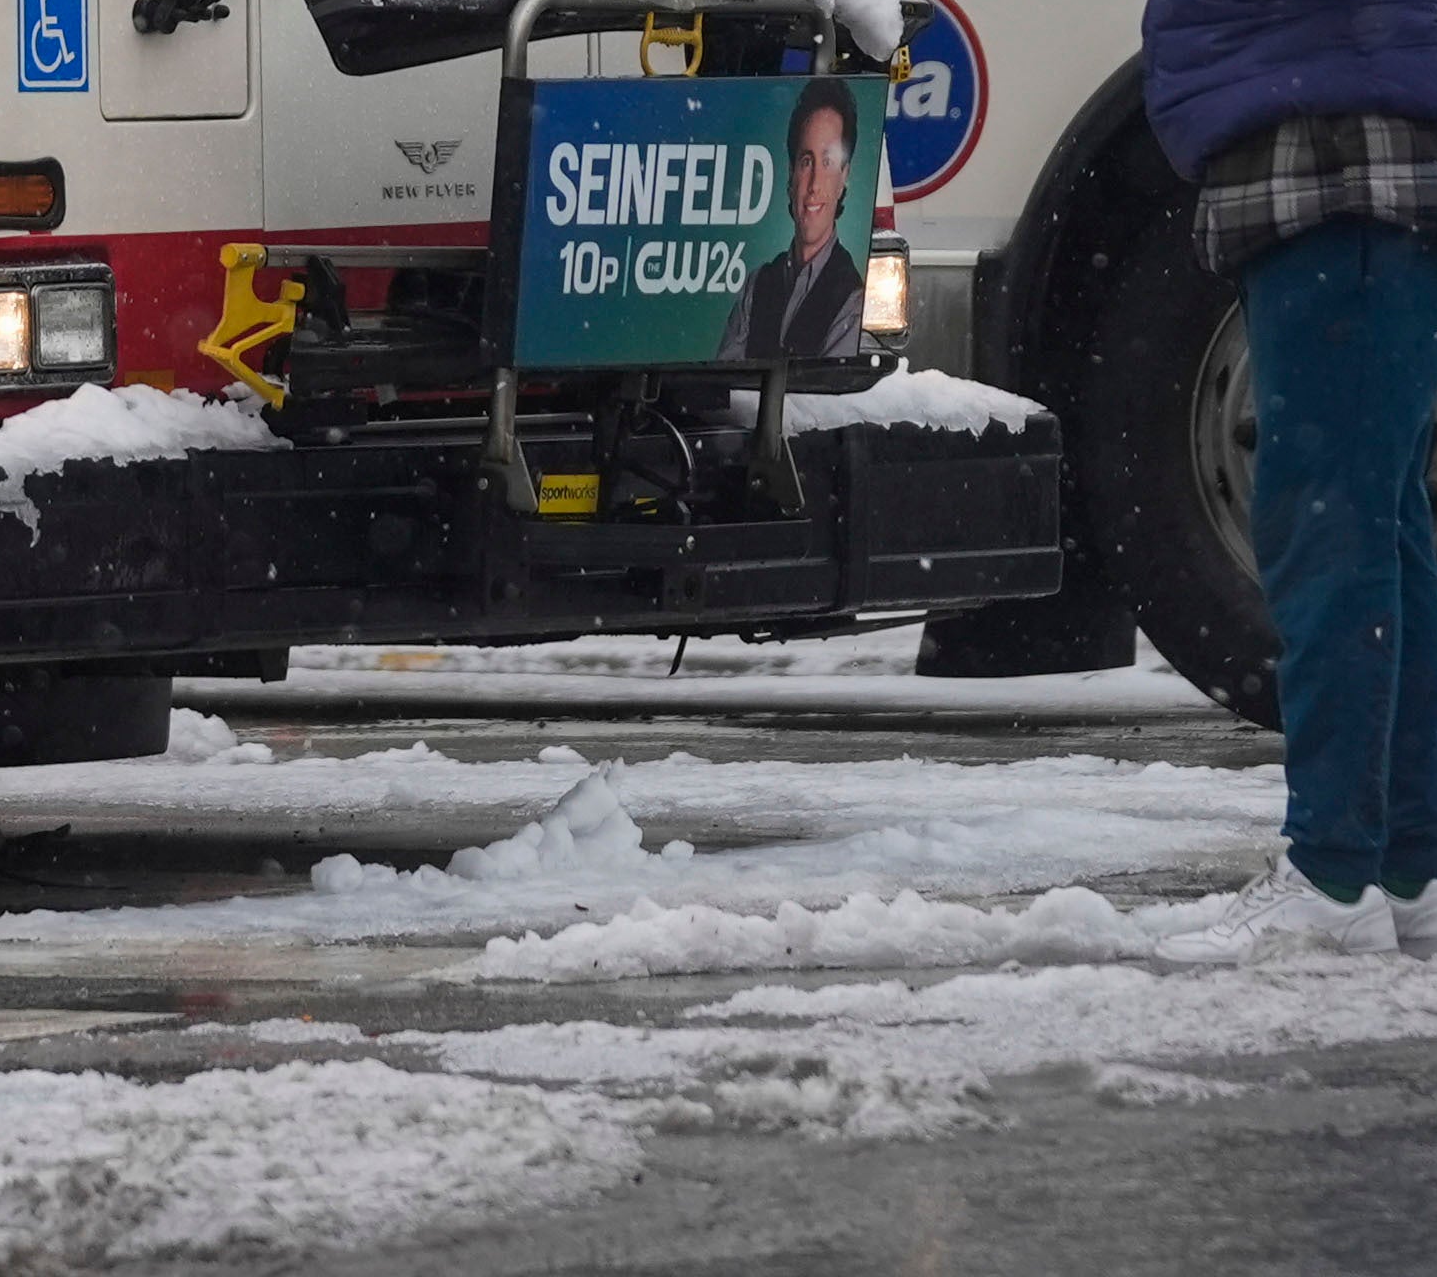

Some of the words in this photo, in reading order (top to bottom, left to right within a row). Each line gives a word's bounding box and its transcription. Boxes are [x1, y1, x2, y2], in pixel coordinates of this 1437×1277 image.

[382, 183, 420, 199] NEW
[425, 183, 476, 198] FLYER
[545, 142, 775, 227] SEINFELD
[541, 485, 597, 502] sportworks
